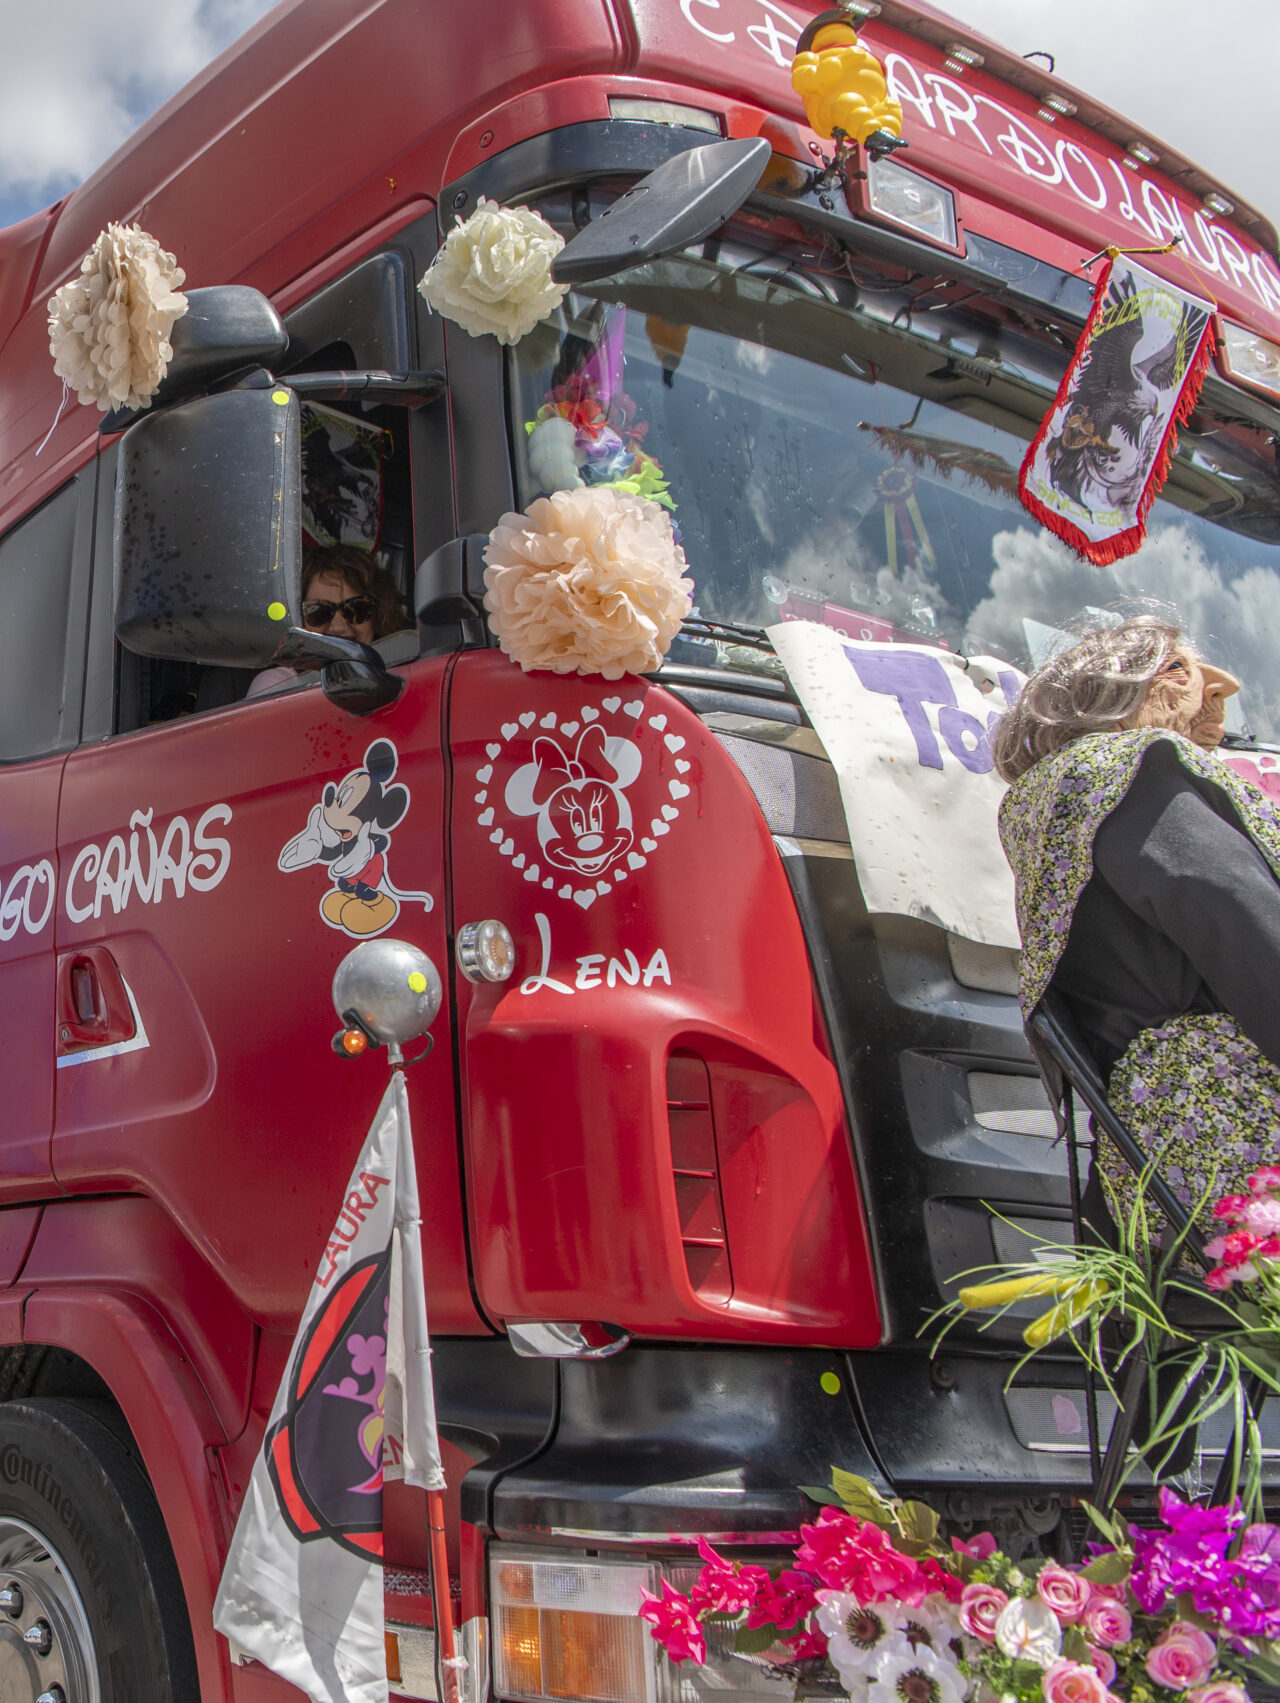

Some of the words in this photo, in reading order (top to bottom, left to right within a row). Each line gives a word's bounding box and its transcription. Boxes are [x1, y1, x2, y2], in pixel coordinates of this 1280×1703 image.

[842, 644, 1020, 774] To
[65, 803, 233, 924] CAÑAS
[315, 1172, 391, 1289] LAURA
